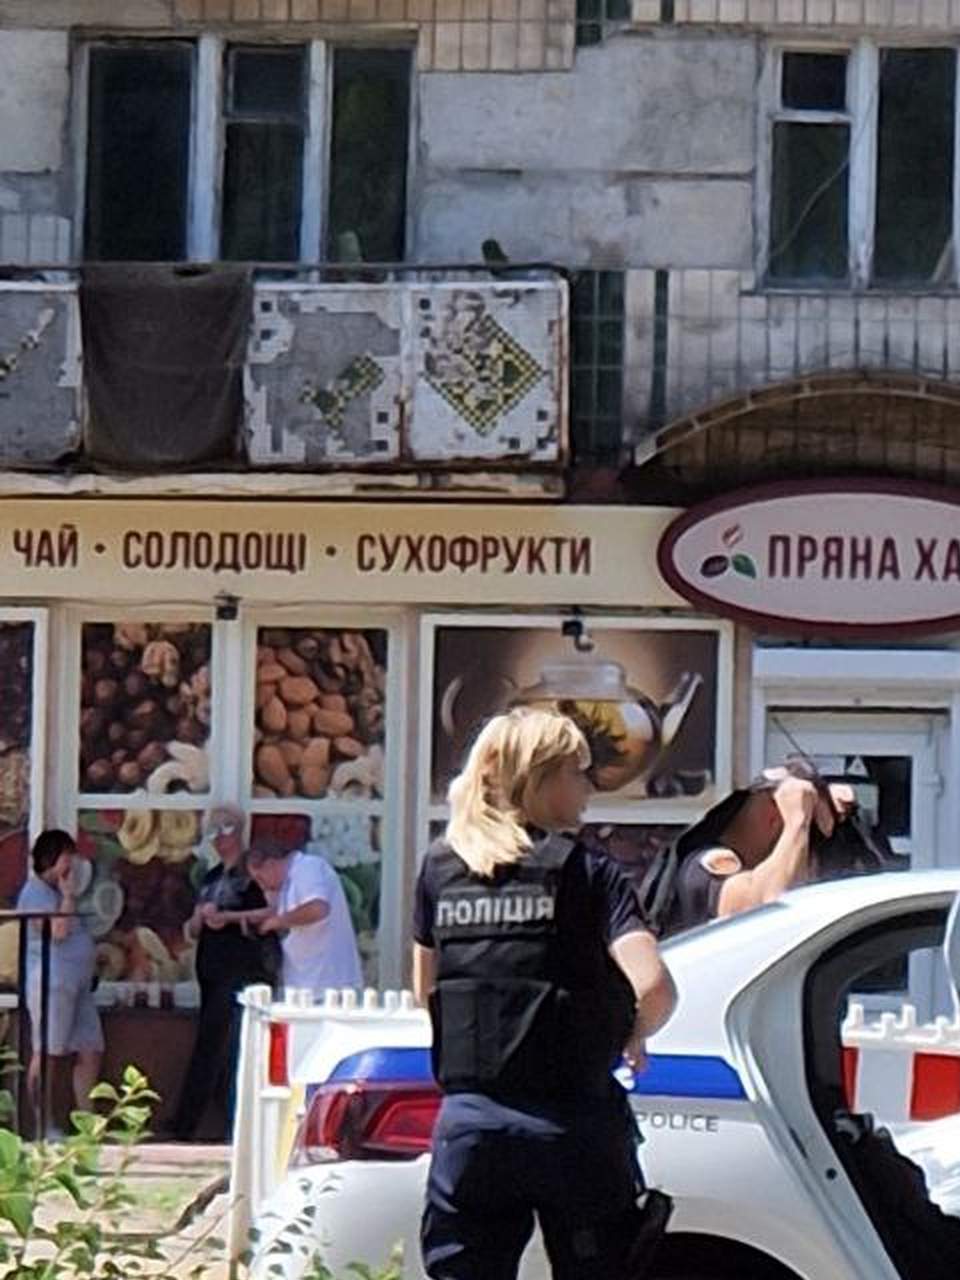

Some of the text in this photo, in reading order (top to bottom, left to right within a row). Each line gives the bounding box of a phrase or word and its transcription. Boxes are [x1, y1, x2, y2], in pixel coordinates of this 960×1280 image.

[14, 525, 592, 575] ЧАЙ СОЛОДОЩІ СУХОФРУКТИ
[768, 535, 900, 580] ПРЯНА
[437, 896, 555, 926] ПОЛІЦІЯ
